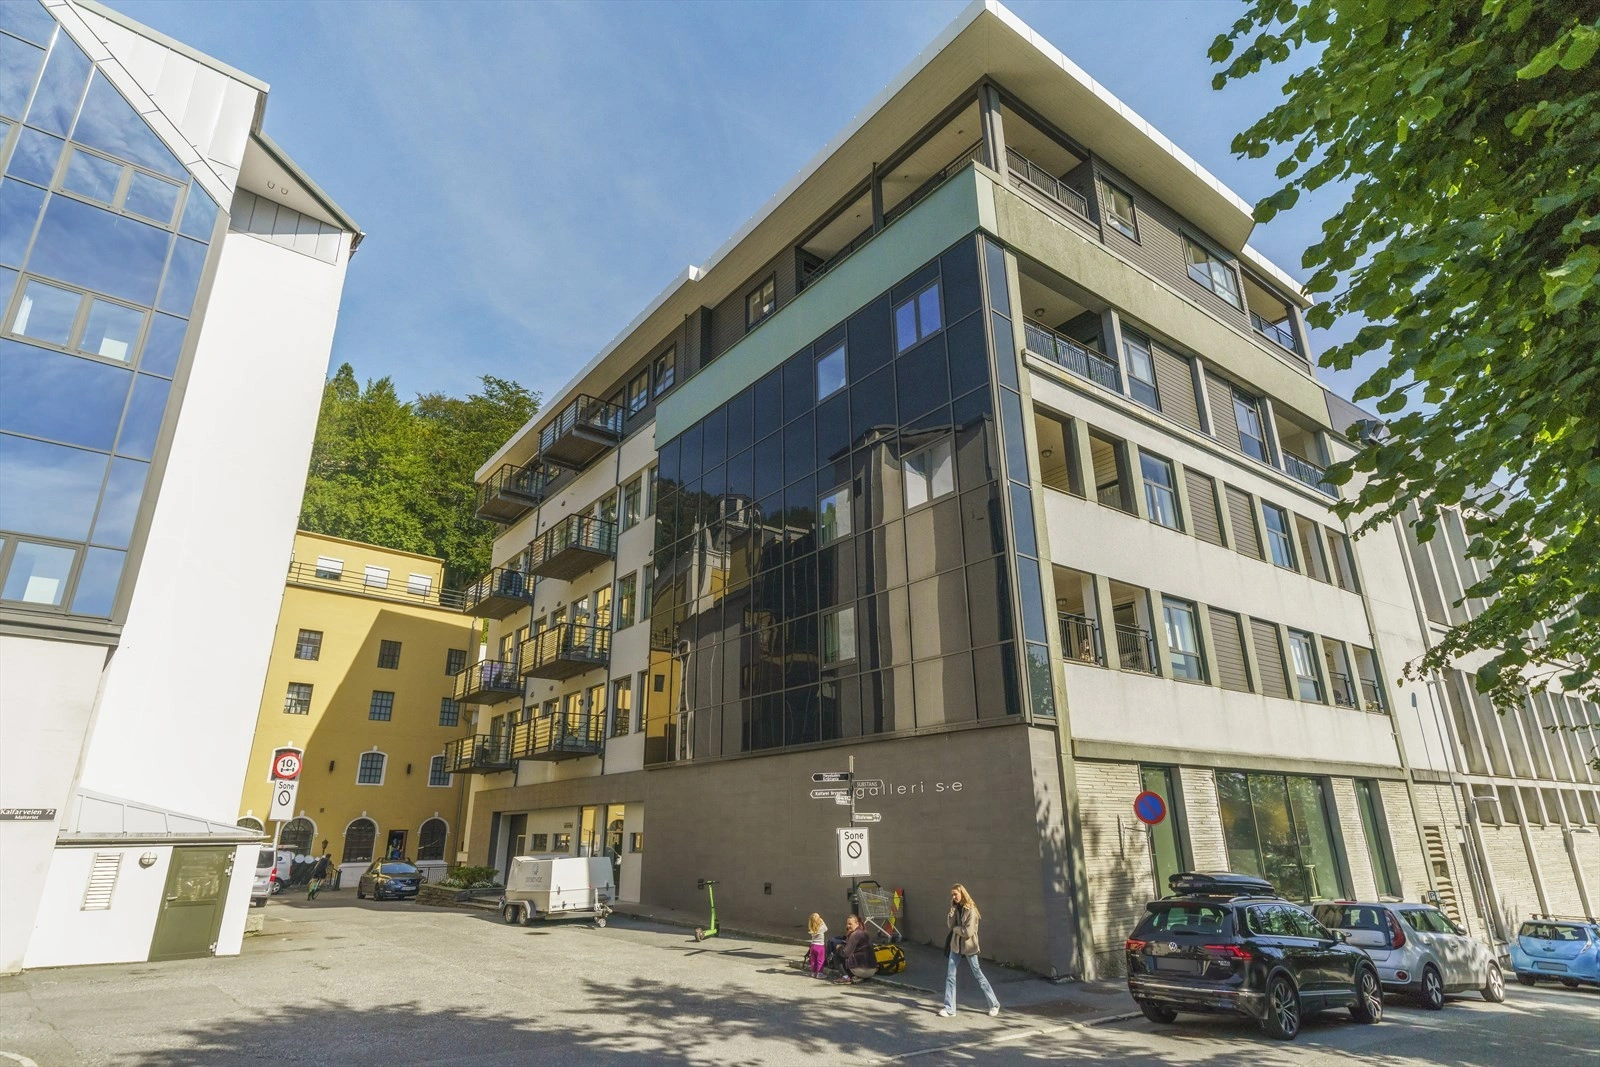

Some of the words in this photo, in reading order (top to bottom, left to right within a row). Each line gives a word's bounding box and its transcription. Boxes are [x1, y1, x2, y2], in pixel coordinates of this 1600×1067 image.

[281, 759, 293, 768] 10
[279, 782, 294, 790] Sone
[855, 781, 924, 799] galleri
[844, 831, 864, 840] Sone
